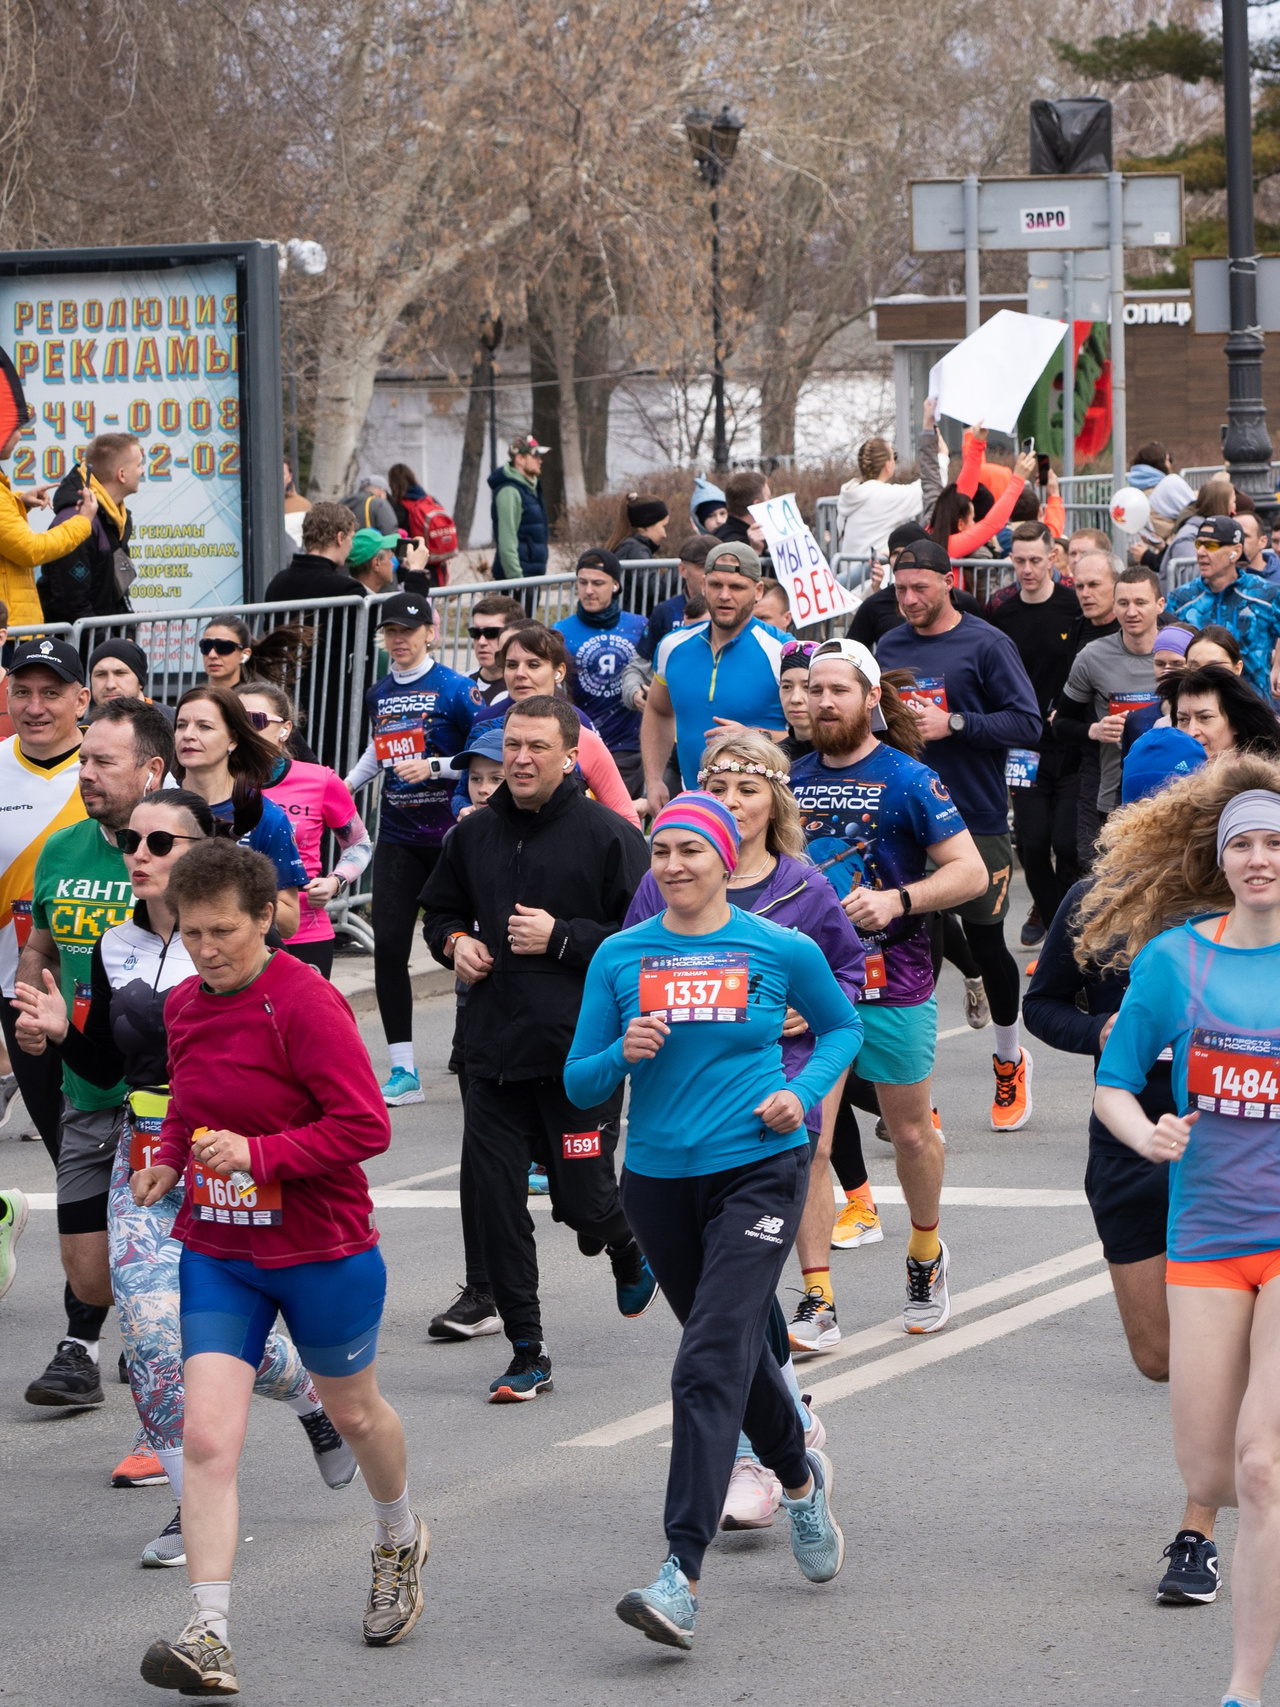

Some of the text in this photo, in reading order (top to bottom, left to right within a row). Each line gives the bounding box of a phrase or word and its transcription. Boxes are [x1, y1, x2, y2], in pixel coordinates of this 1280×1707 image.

[1026, 211, 1065, 229] ЗАРО
[14, 293, 238, 334] РЕВОЛЮЦИЯ
[14, 335, 239, 388] РЕКЛАМЫ
[140, 525, 204, 538] РЕКЛАМЫ
[146, 543, 239, 558] ПАВИЛЬОНАХ,
[386, 736, 415, 757] 1481
[664, 980, 722, 1006] 1337
[1212, 1065, 1279, 1100] 1484
[565, 1137, 599, 1153] 1591
[744, 1229, 760, 1238] new
